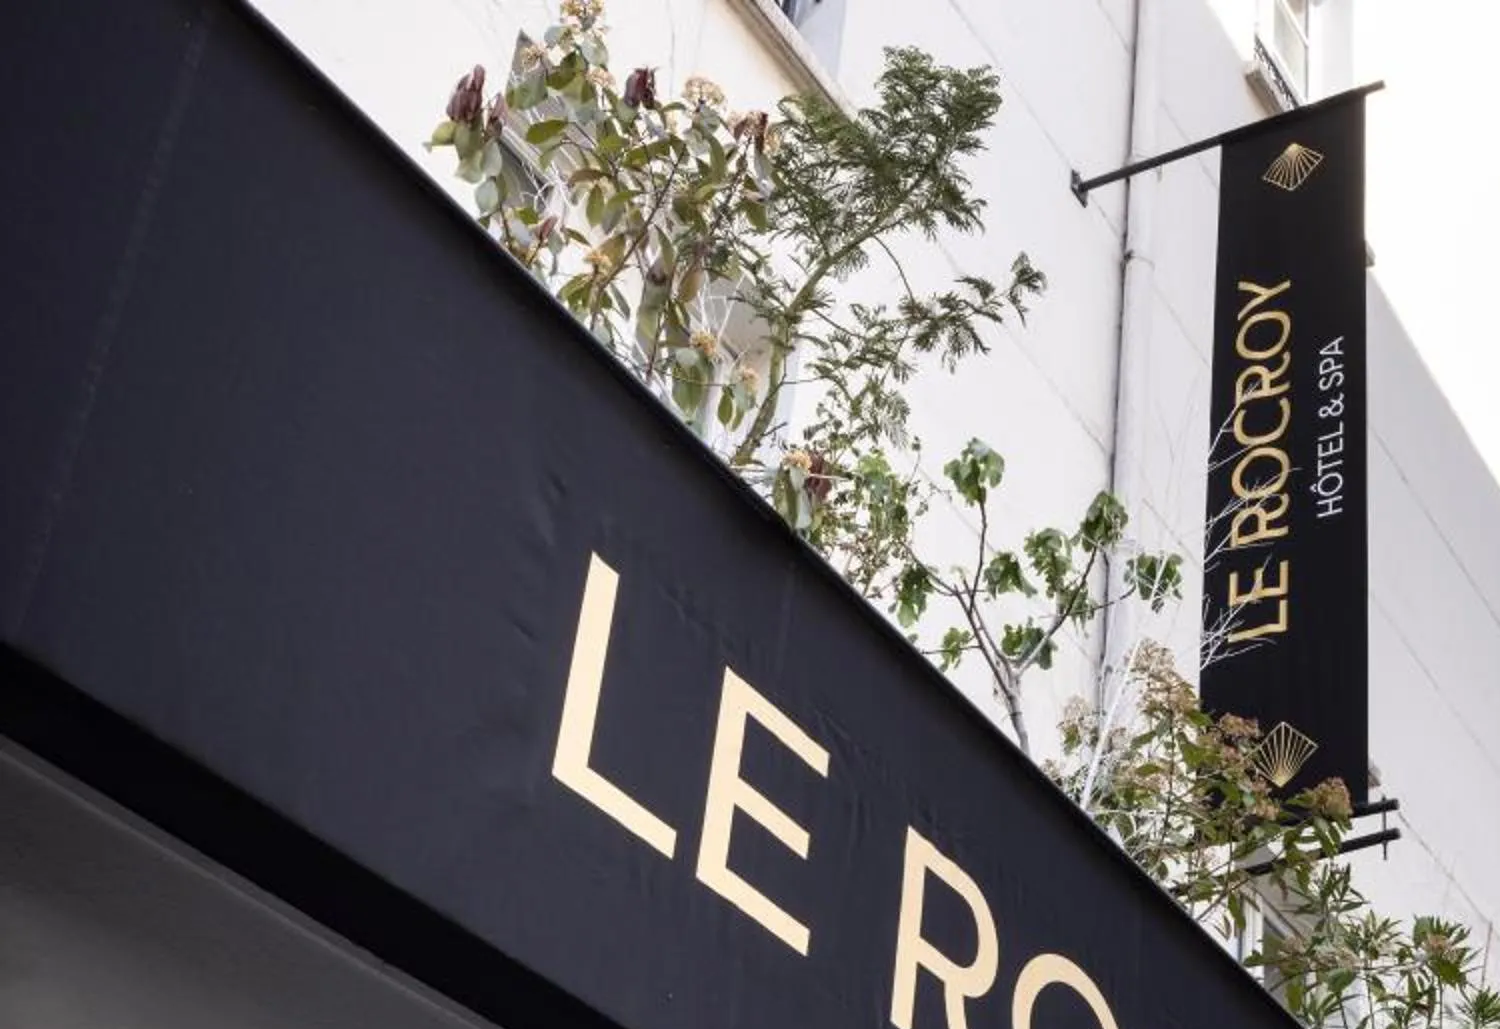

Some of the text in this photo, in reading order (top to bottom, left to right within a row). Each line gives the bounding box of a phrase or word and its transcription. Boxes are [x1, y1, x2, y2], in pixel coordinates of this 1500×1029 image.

[1227, 279, 1292, 645] LE ROCROY
[1311, 336, 1345, 518] HÔTEL & SPA
[551, 551, 830, 957] LE
